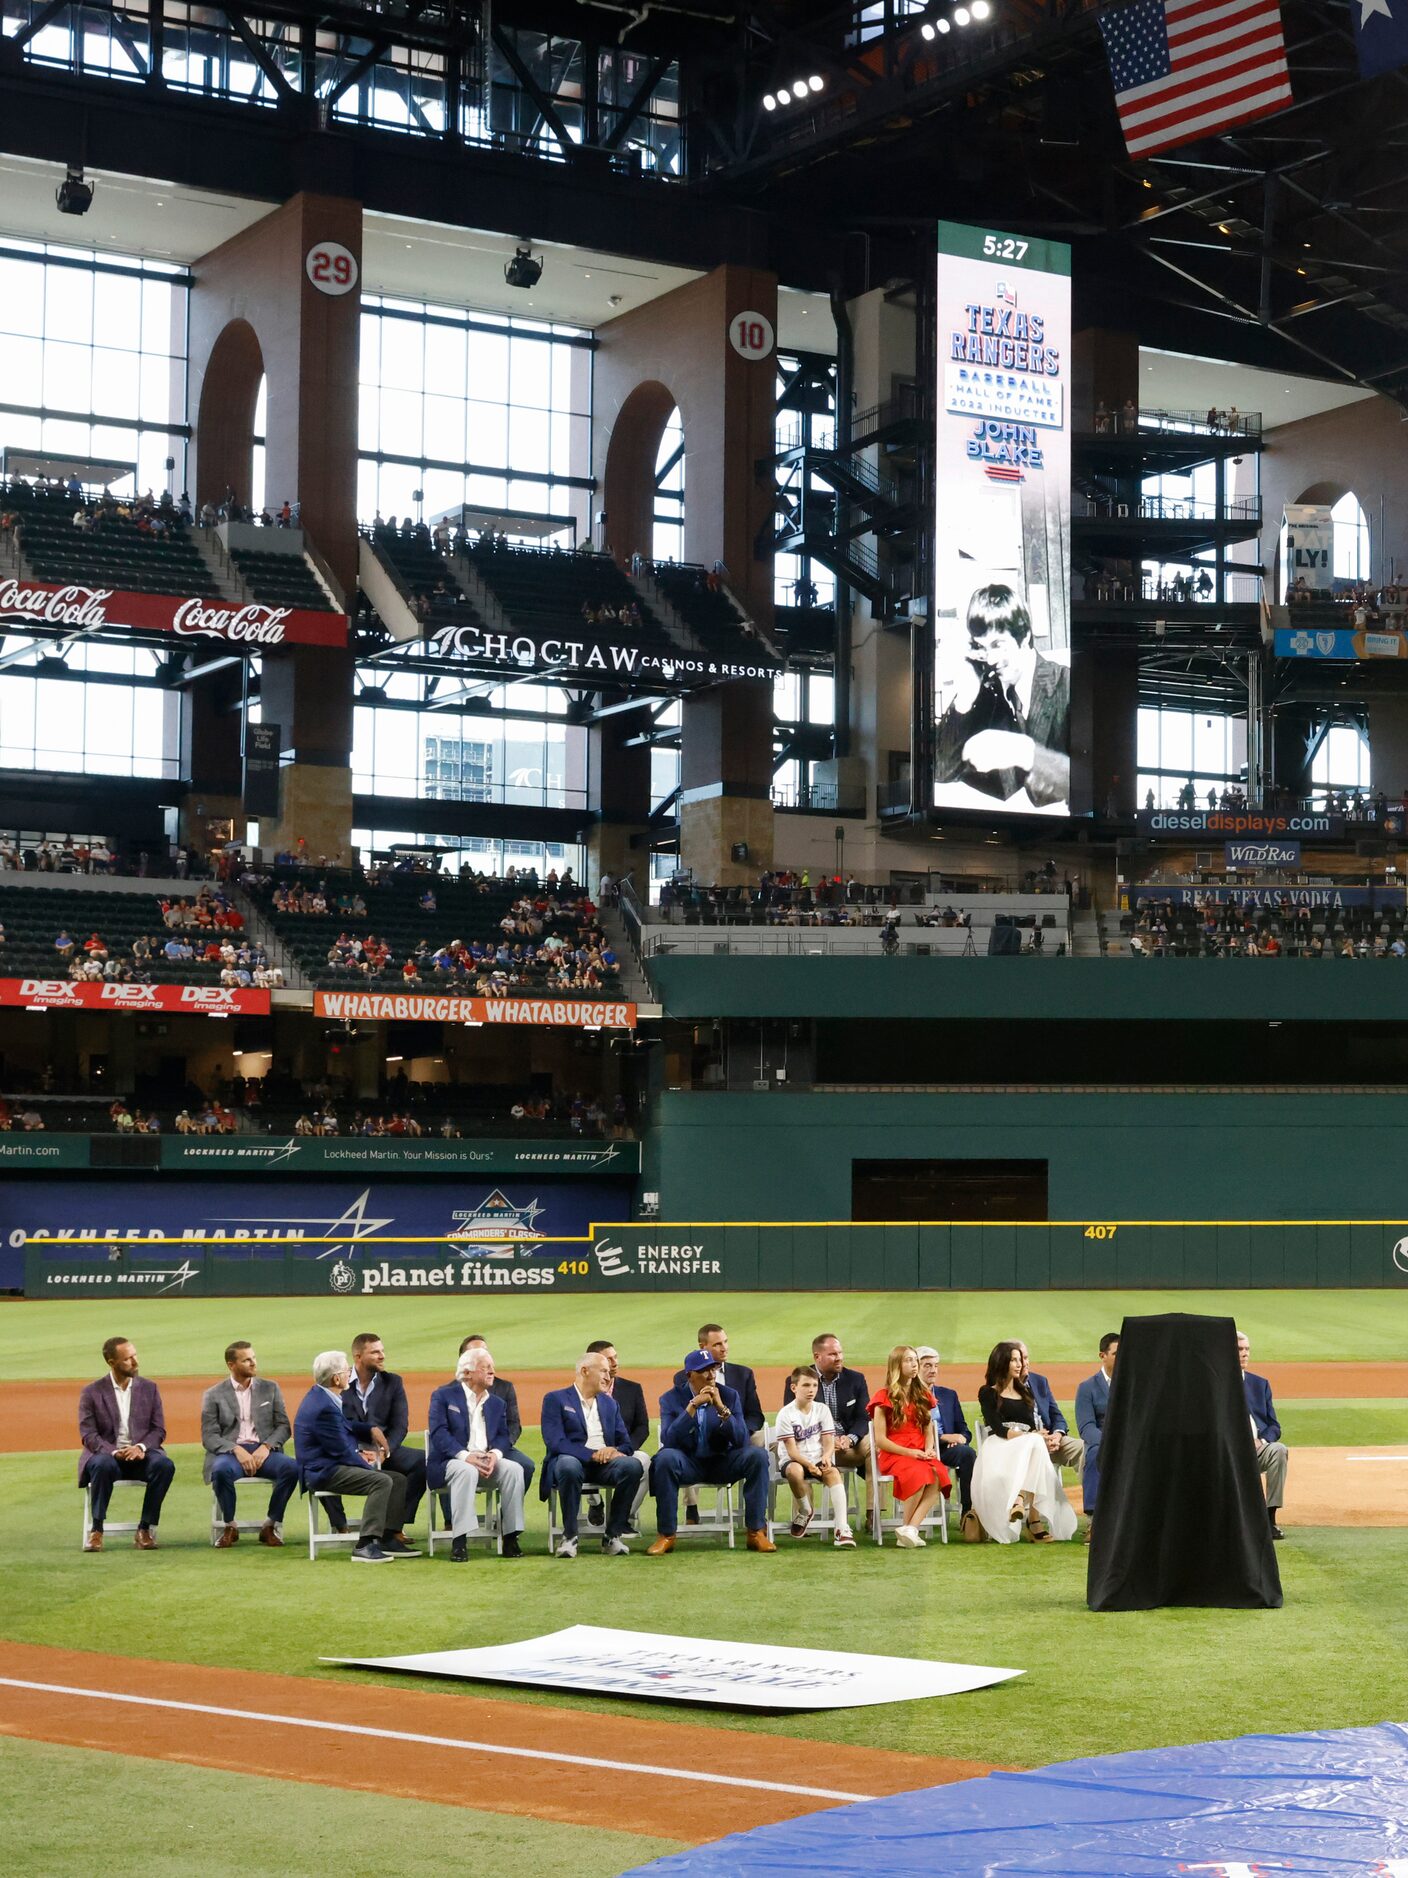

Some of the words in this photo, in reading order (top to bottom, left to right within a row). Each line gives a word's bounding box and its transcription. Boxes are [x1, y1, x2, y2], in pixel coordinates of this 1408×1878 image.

[983, 236, 1028, 260] 5:27
[312, 251, 352, 285] 29
[966, 303, 1044, 343] TEXAS
[738, 321, 764, 350] 10
[951, 331, 1059, 376] RANGERS
[960, 369, 1051, 395] BASEBALL
[956, 384, 990, 398] HALL
[996, 391, 1012, 400] OF
[1019, 394, 1053, 407] FAME
[951, 398, 983, 410] 2022
[989, 404, 1055, 421] INDUCTEE
[974, 419, 1036, 444] JOHN
[966, 439, 1044, 468] BLAKE
[1296, 549, 1328, 568] LY!
[173, 598, 293, 644] Coca-Cola
[455, 627, 638, 672] CHOCTAW
[641, 656, 704, 673] CASINOS
[708, 663, 717, 673] &
[721, 664, 783, 679] RESORTS
[1151, 813, 1330, 834] dieseldisplays.com
[1231, 844, 1269, 860] WILD
[1267, 847, 1295, 860] RAG
[1289, 890, 1342, 908] VODKA
[19, 979, 79, 997] DEX
[101, 983, 159, 1000] DEX
[181, 986, 237, 1004] DEX
[33, 995, 84, 1006] imaging
[115, 999, 164, 1009] imaging
[194, 1001, 241, 1012] imaging
[323, 994, 473, 1020] WHATABURGER
[485, 1001, 628, 1025] WHATABURGER
[184, 1148, 235, 1156] LOCKHEED
[324, 1150, 367, 1160] Lockheed
[403, 1151, 422, 1160] Your
[425, 1151, 458, 1160] Mission
[459, 1152, 468, 1160] is
[1084, 1226, 1117, 1239] 407
[638, 1245, 703, 1260] ENERGY
[558, 1261, 589, 1275] 410
[638, 1261, 721, 1274] TRANSFER
[47, 1274, 112, 1283] LOCKHEED
[117, 1274, 166, 1283] MARTIN
[361, 1263, 453, 1293] planet
[461, 1262, 555, 1286] fitness
[700, 1351, 708, 1359] T
